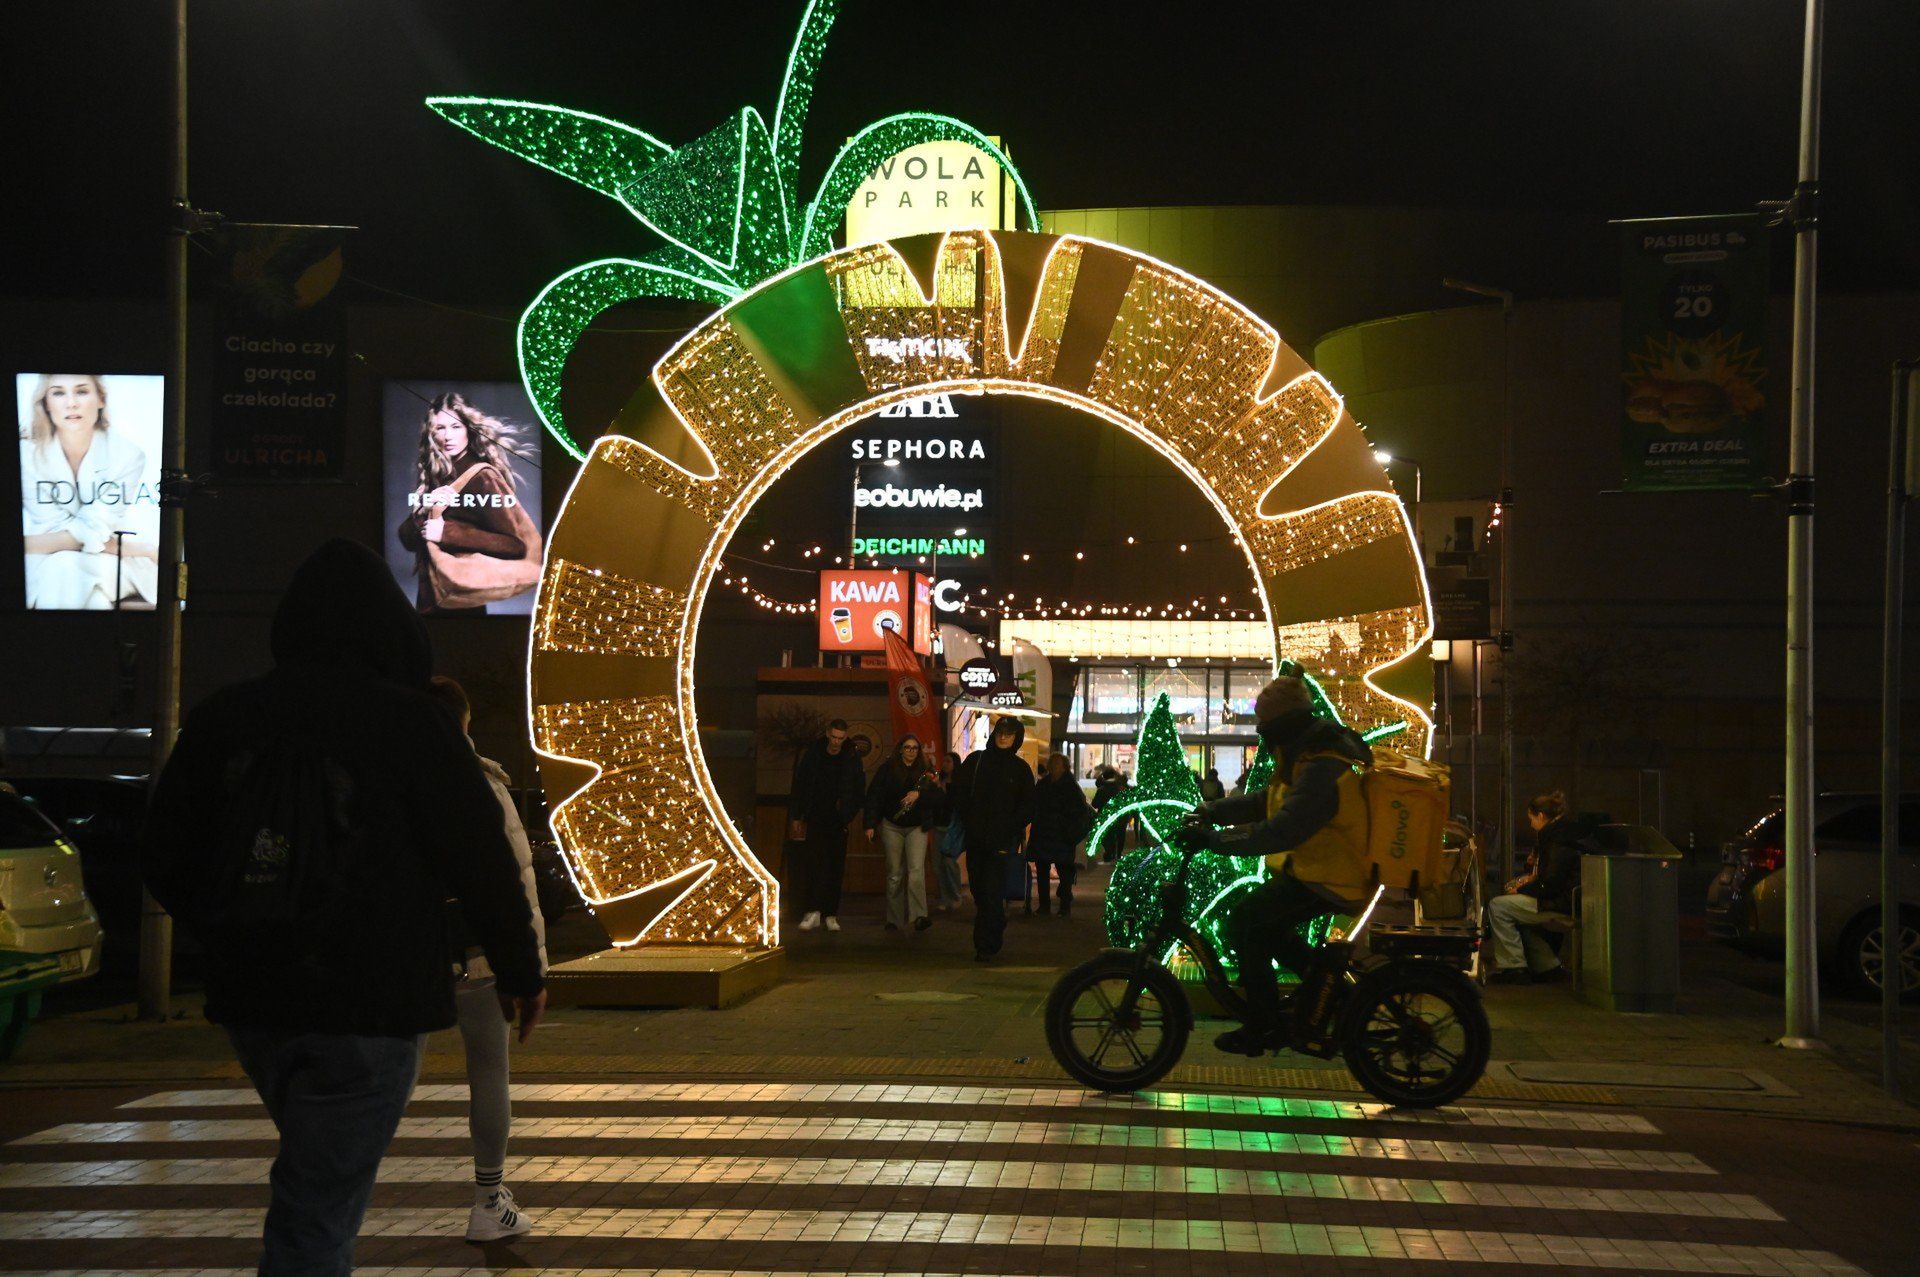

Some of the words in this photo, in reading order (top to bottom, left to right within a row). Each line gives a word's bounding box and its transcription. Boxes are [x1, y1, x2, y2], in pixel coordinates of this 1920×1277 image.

[869, 156, 985, 181] WOLA
[865, 190, 985, 208] PARK
[1643, 233, 1721, 249] PASIBUS
[1674, 296, 1713, 318] 20
[225, 336, 297, 353] Ciacho
[301, 343, 336, 358] czy
[244, 367, 317, 384] gorąca
[222, 391, 337, 408] czekolada?
[851, 439, 986, 459] SEPHORA
[1649, 441, 1698, 454] EXTRA
[1703, 438, 1744, 451] DEAL
[225, 448, 328, 465] ULRICHA
[407, 492, 517, 508] RESERVED
[854, 483, 983, 512] eobuwie.pl
[853, 538, 985, 555] DEICHMANN
[830, 580, 901, 603] KAWA
[961, 672, 996, 683] COSTA
[992, 696, 1022, 706] COSTA
[1391, 806, 1408, 859] Glovo
